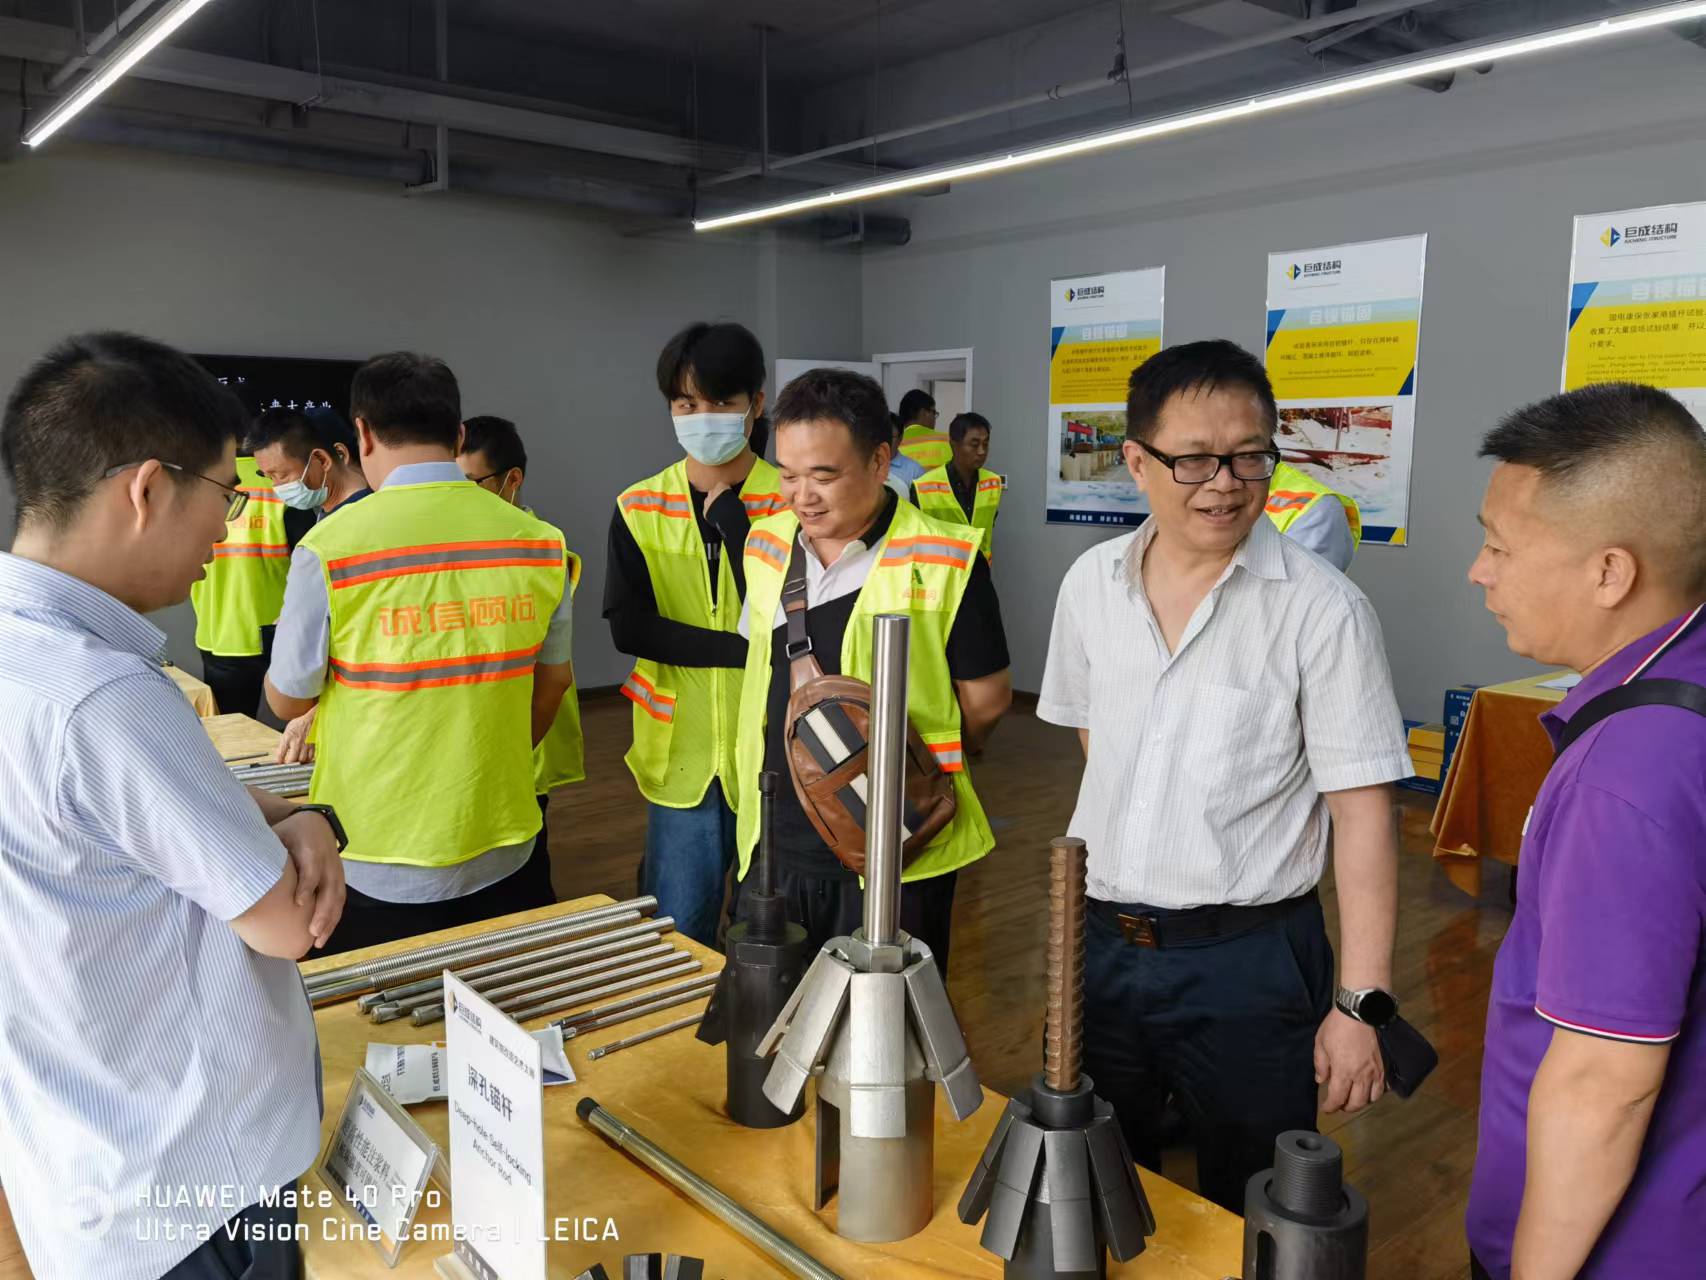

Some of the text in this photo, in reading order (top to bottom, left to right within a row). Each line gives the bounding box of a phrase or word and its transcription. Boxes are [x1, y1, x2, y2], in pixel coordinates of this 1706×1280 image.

[1625, 222, 1678, 238] 巨成结构
[1303, 260, 1342, 273] 巨成结构
[379, 592, 537, 638] 诚信顾问
[468, 1063, 513, 1122] 深孔锚杆
[472, 1138, 513, 1186] Anchor Rod
